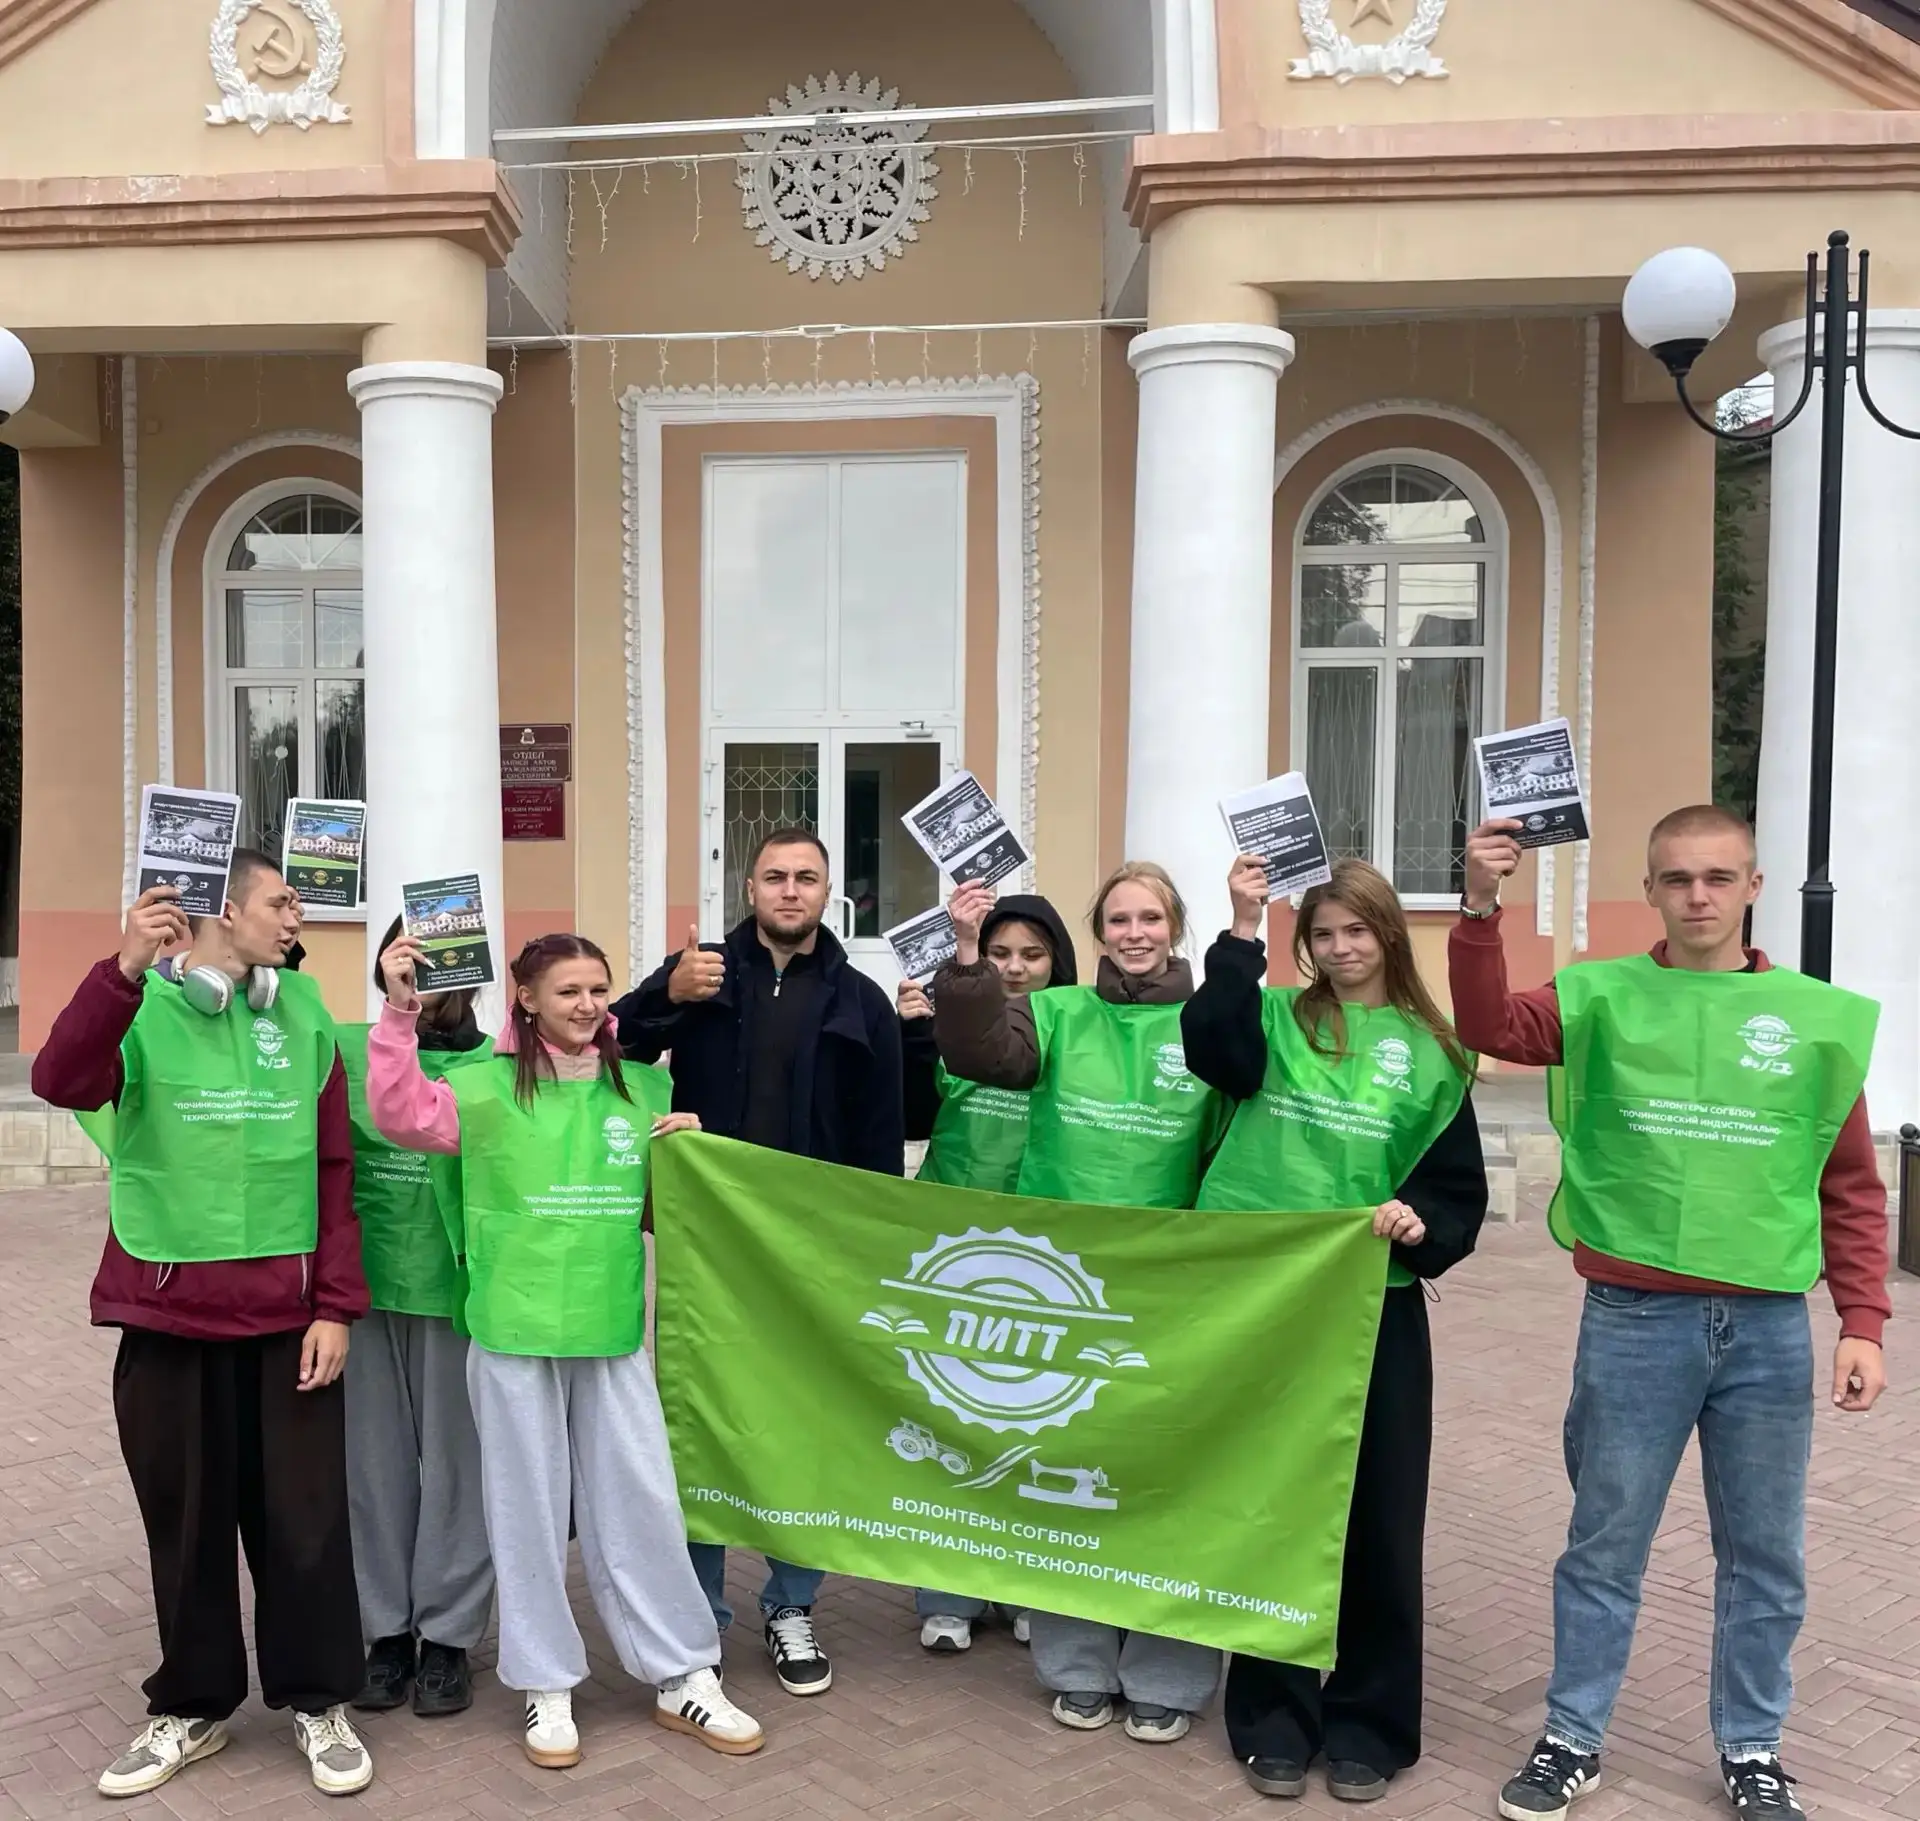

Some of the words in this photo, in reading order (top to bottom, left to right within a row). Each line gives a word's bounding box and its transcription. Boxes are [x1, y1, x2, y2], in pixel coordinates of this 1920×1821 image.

[513, 751, 545, 760] ОТДЕЛ
[1649, 1099, 1708, 1113] ВОЛОНТЕРЫ
[1710, 1105, 1757, 1119] СОГБПОУ
[1628, 1122, 1719, 1141] ТЕХНОЛОГИЧЕСКИЙ
[944, 1309, 1069, 1362] ПИТТ
[891, 1496, 1007, 1534] ВОЛОНТЕРЫ
[1011, 1522, 1101, 1550] СОГБПОУ
[845, 1515, 1201, 1601] ИНДУСТРИАЛЬНО-ТЕХНОЛОГИЧЕСКИЙ
